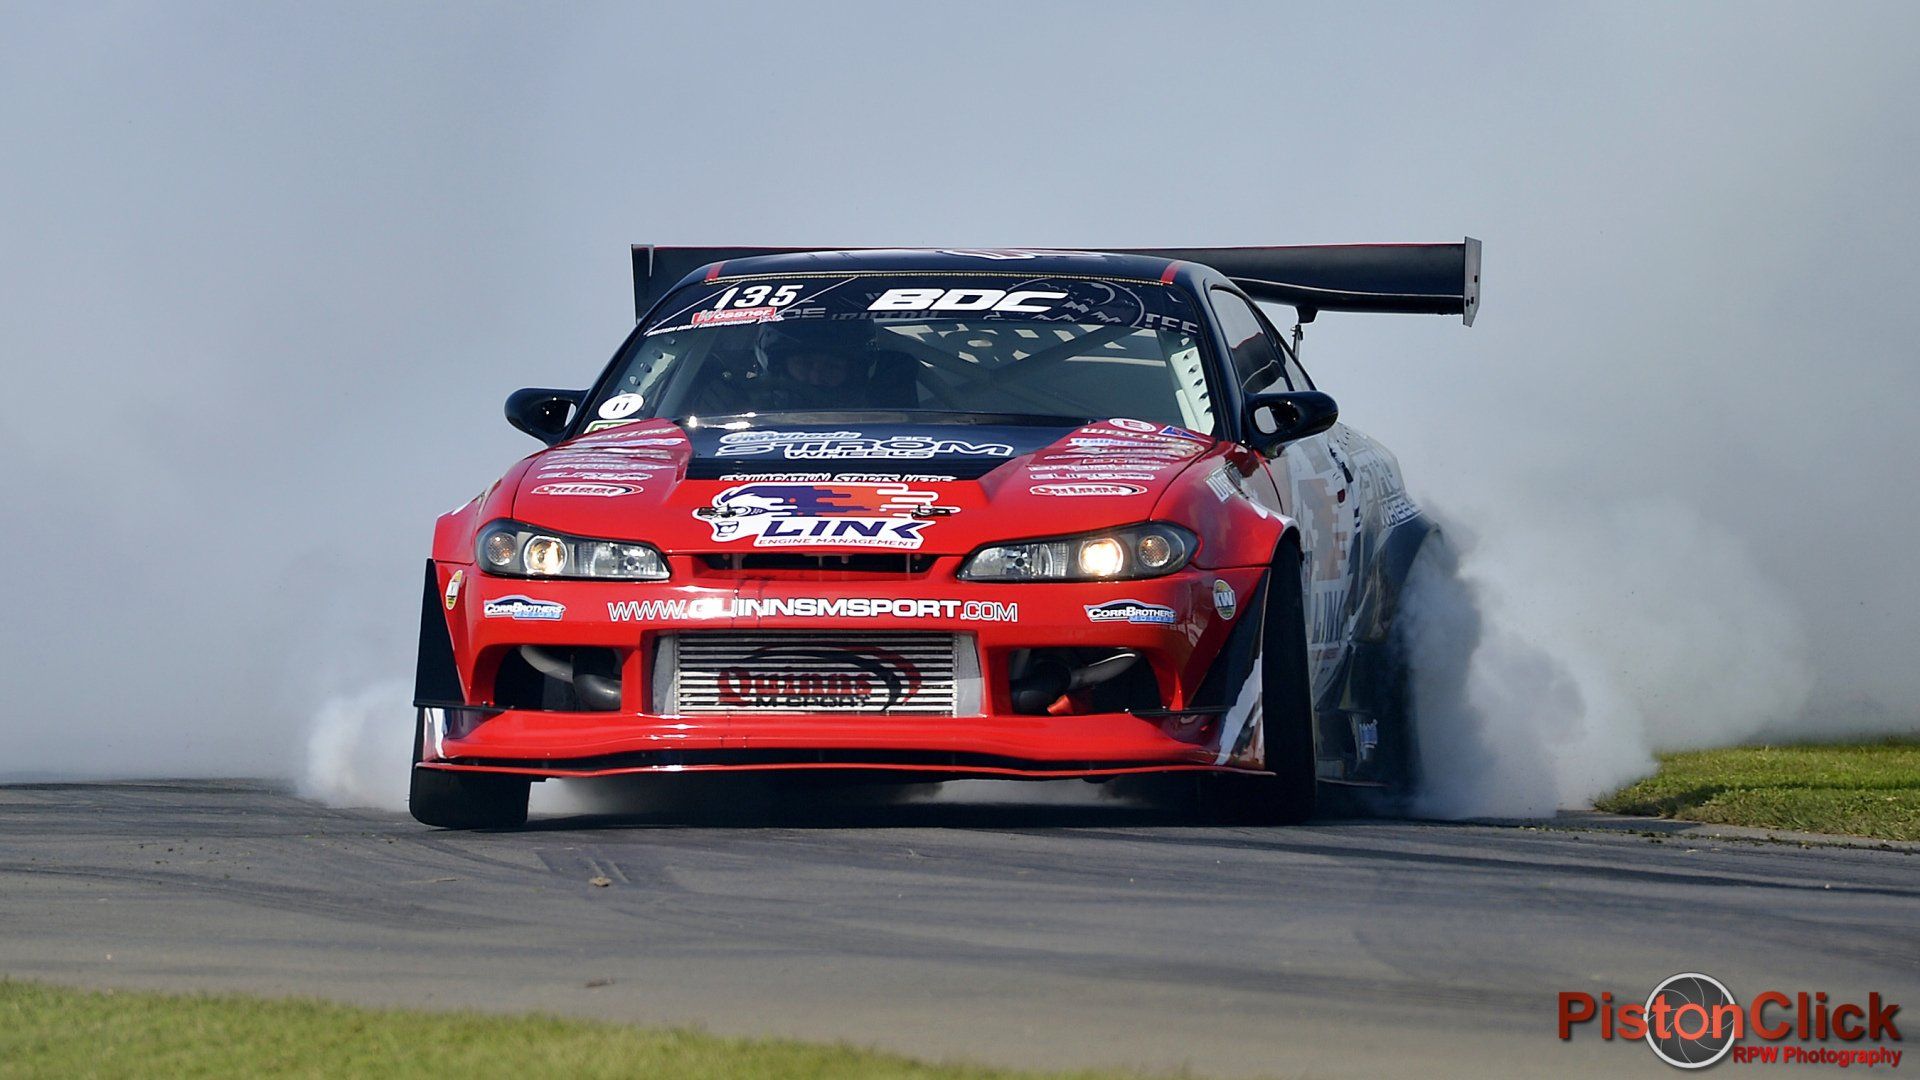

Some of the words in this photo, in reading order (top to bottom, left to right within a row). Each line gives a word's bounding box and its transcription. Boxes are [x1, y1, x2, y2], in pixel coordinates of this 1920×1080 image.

[714, 285, 803, 309] 135
[867, 288, 1069, 312] BDC
[787, 450, 932, 458] WHEELS
[762, 520, 927, 539] LINK
[815, 538, 918, 547] MANAGEMENT
[607, 598, 1018, 622] WWW.QUINNSMSPORT.COM
